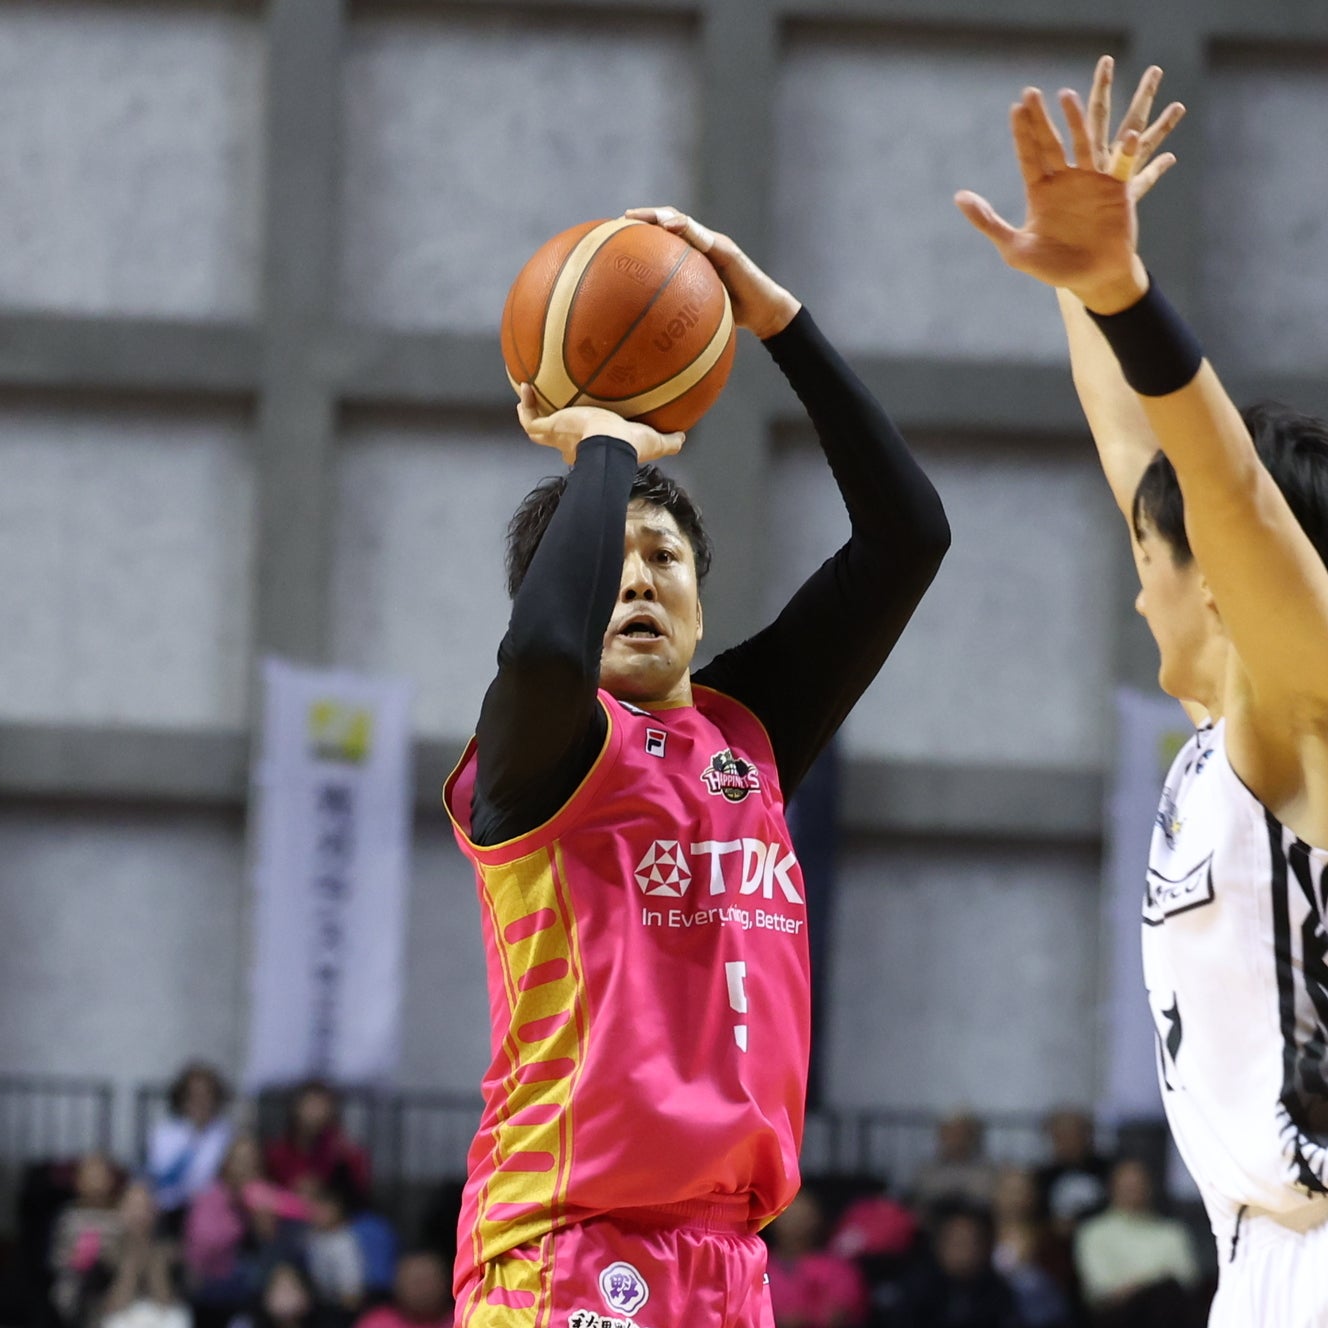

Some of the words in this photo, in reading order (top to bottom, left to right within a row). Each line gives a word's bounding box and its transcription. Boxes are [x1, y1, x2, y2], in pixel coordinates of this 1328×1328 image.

[690, 837, 805, 905] TDK
[642, 907, 662, 927] In
[755, 909, 804, 934] Better
